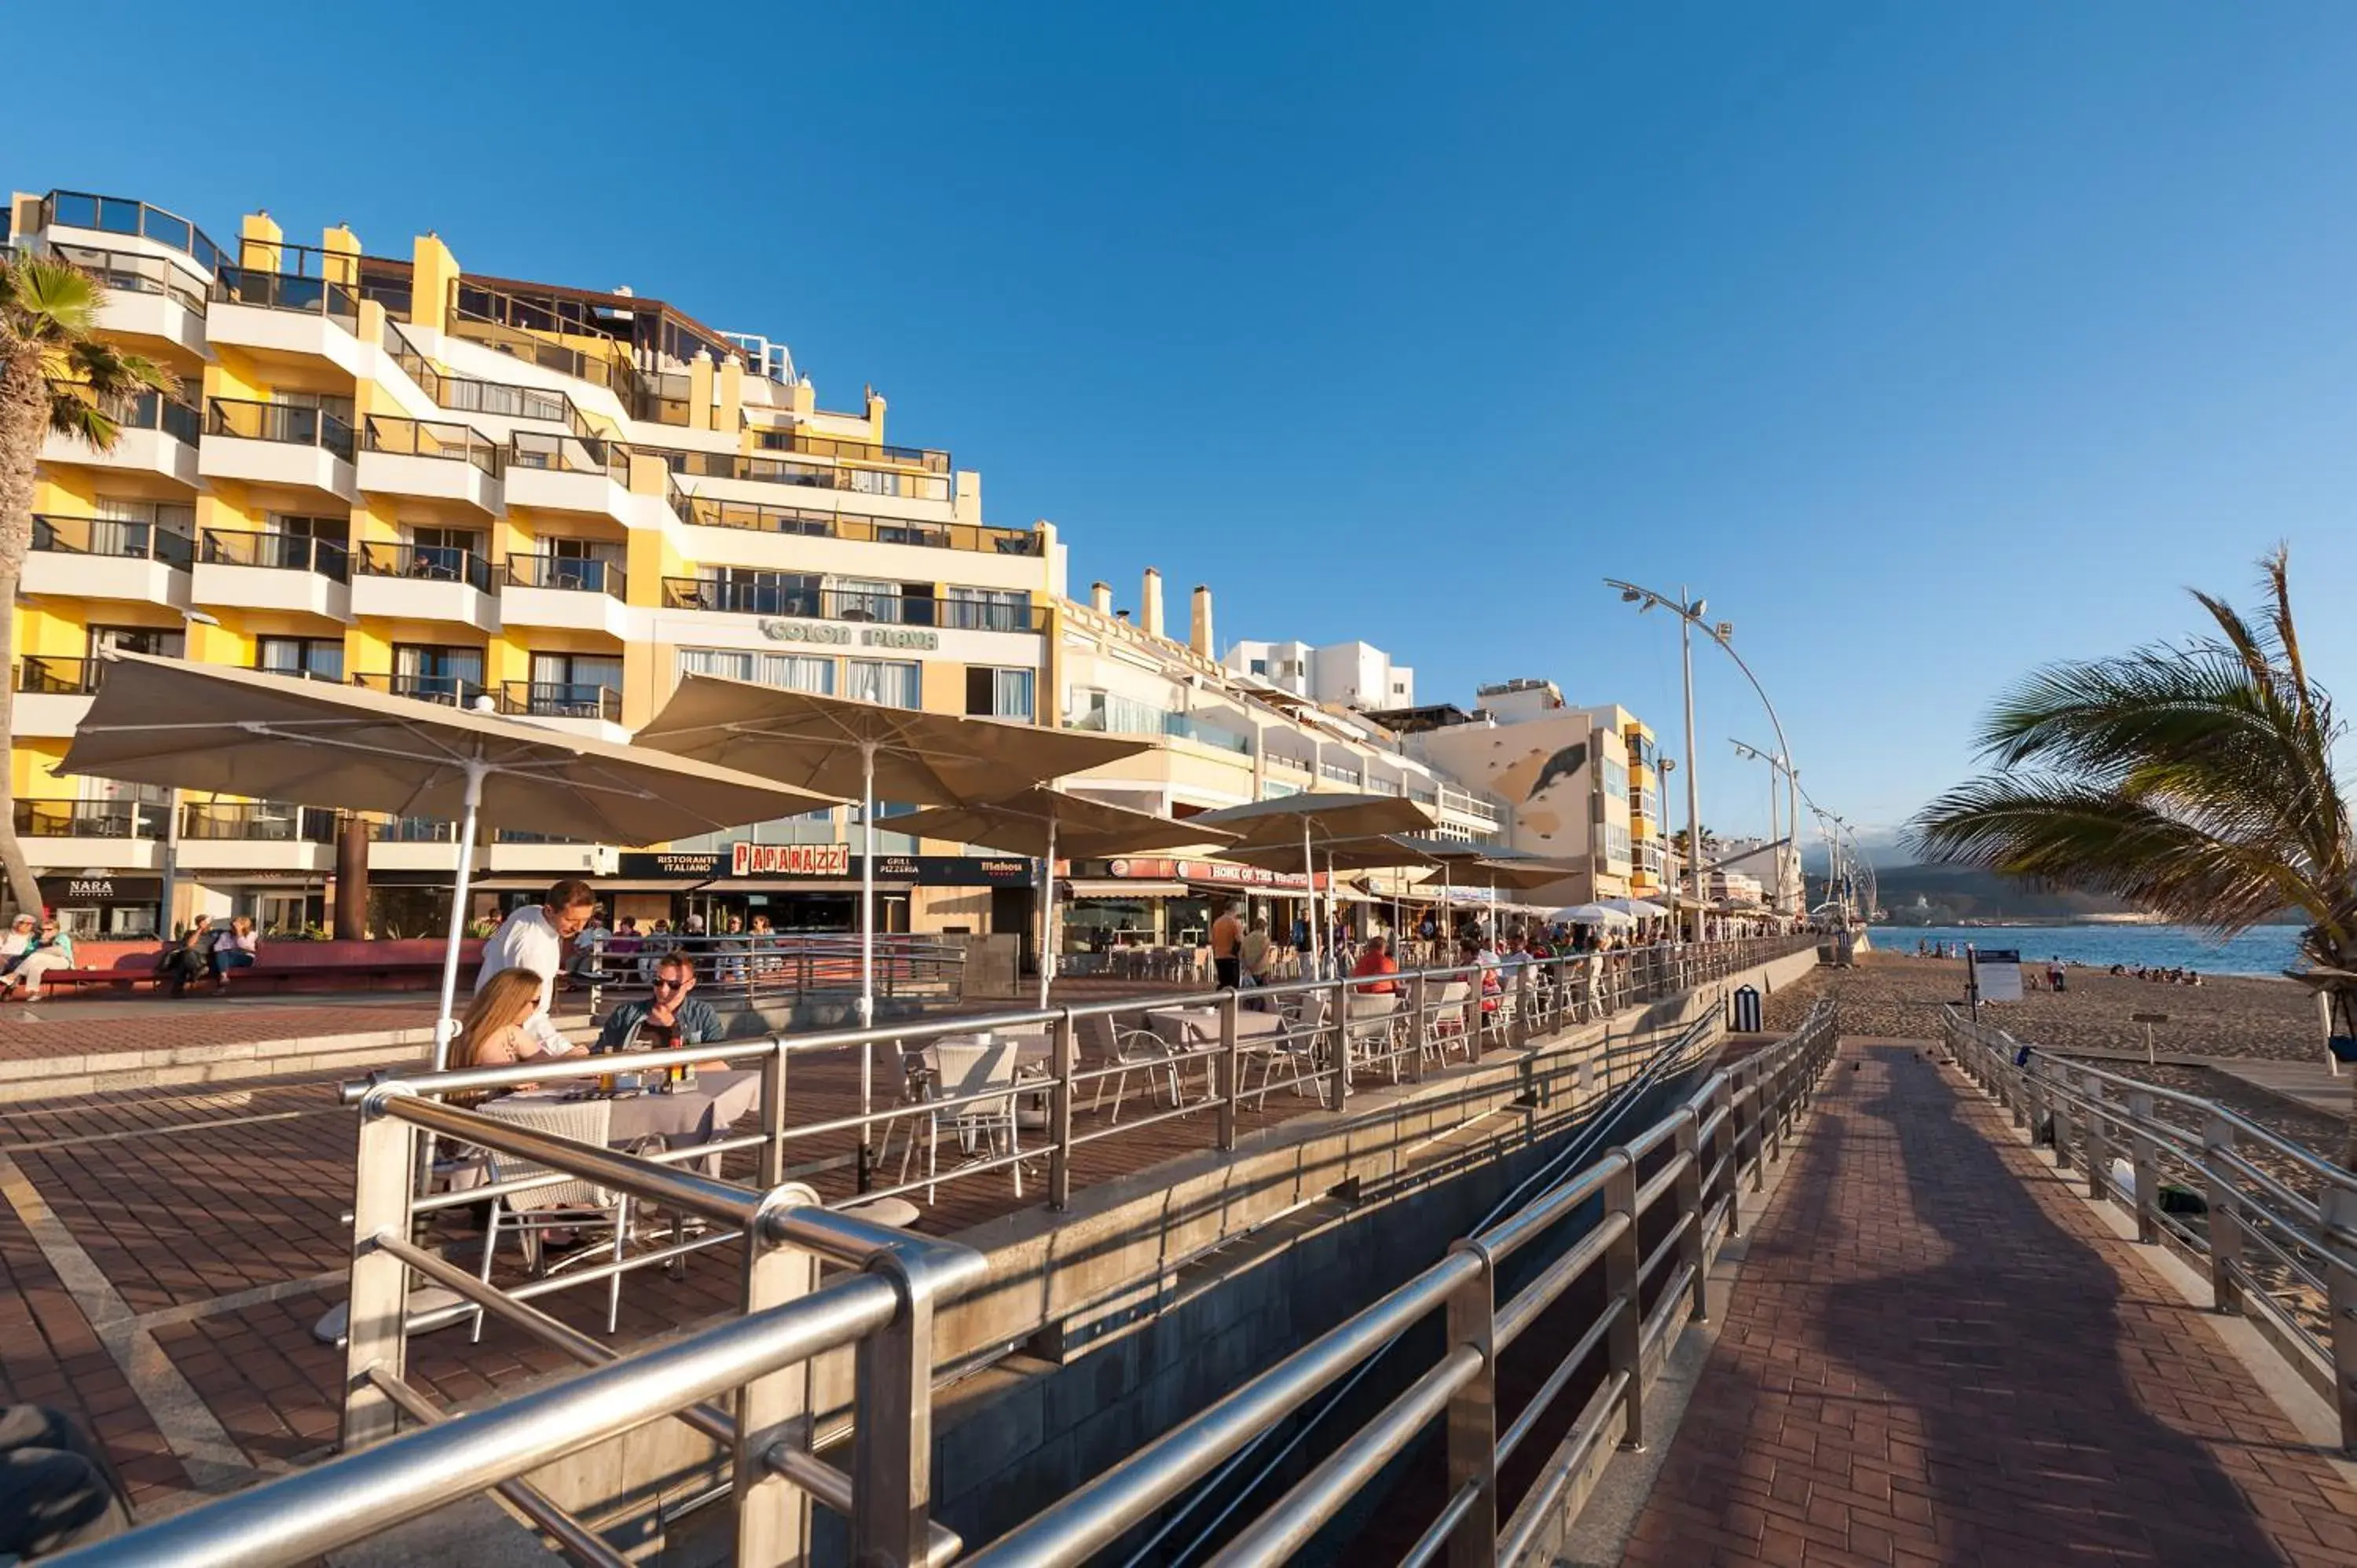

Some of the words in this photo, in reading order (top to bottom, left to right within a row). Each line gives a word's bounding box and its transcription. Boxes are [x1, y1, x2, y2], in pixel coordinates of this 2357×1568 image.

[658, 855, 717, 864] RISTORANTE
[735, 845, 847, 871] PAPARAZZI
[664, 863, 711, 872] ITALIANO
[1213, 866, 1239, 879] HOME
[1241, 868, 1253, 881] OF
[1255, 869, 1273, 881] THE
[70, 881, 112, 892] NARA
